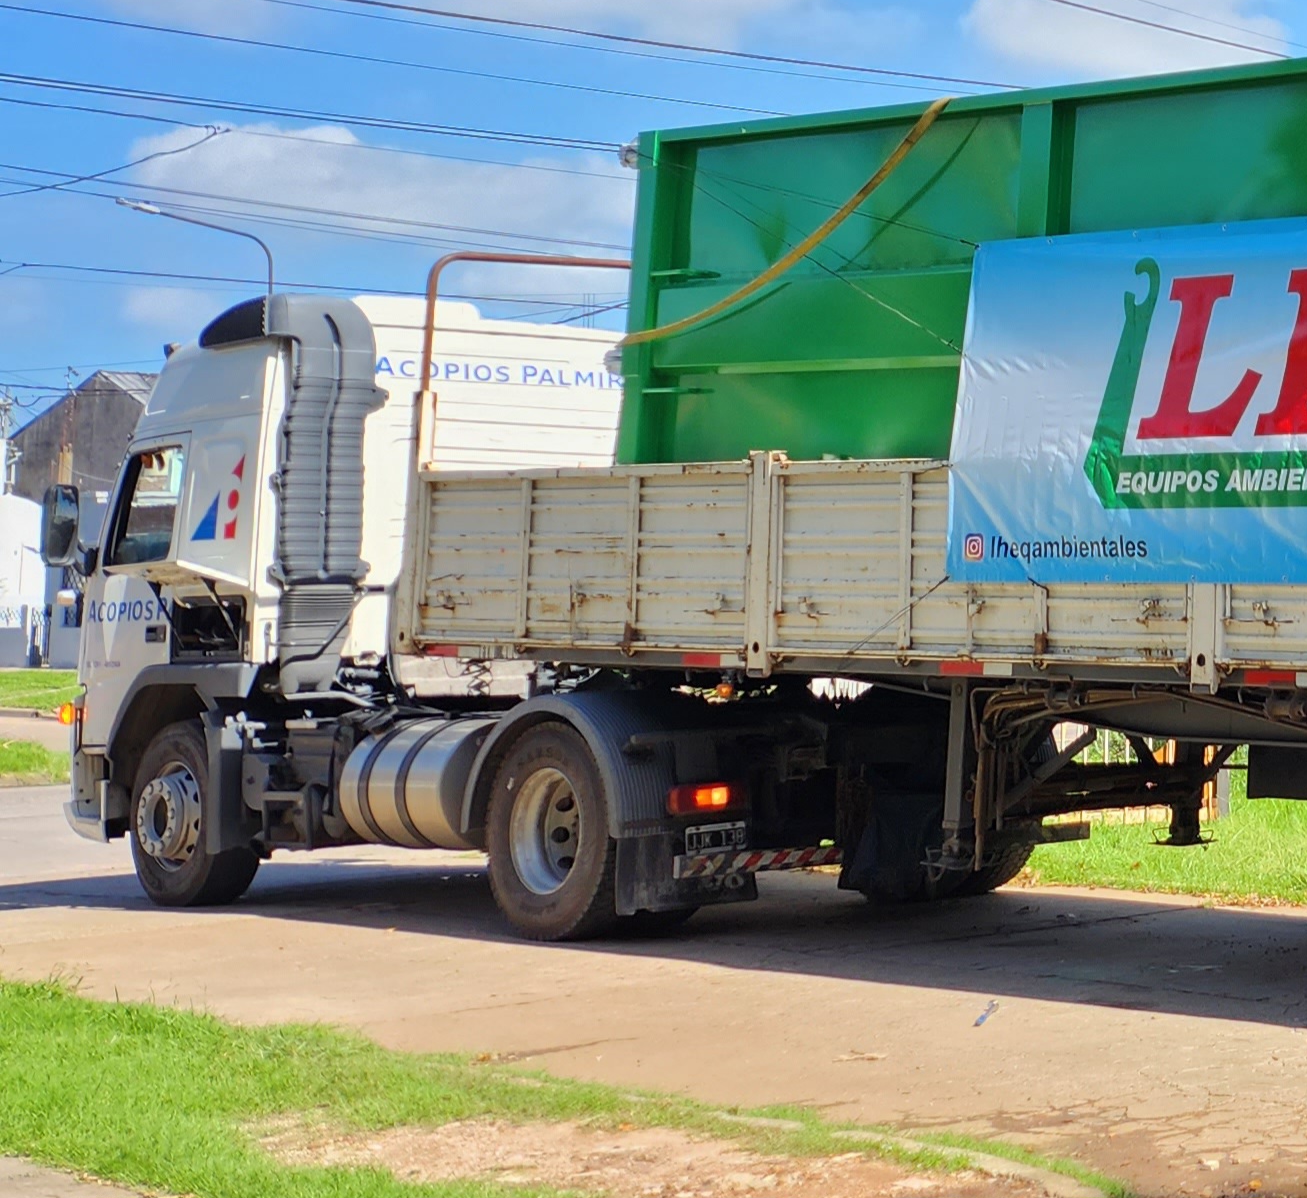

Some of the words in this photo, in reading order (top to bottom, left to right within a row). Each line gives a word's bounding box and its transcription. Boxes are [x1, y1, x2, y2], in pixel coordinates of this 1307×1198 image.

[1116, 470, 1219, 496] EQUIPOS
[88, 599, 154, 623] ACOPIOS
[720, 828, 744, 845] 138
